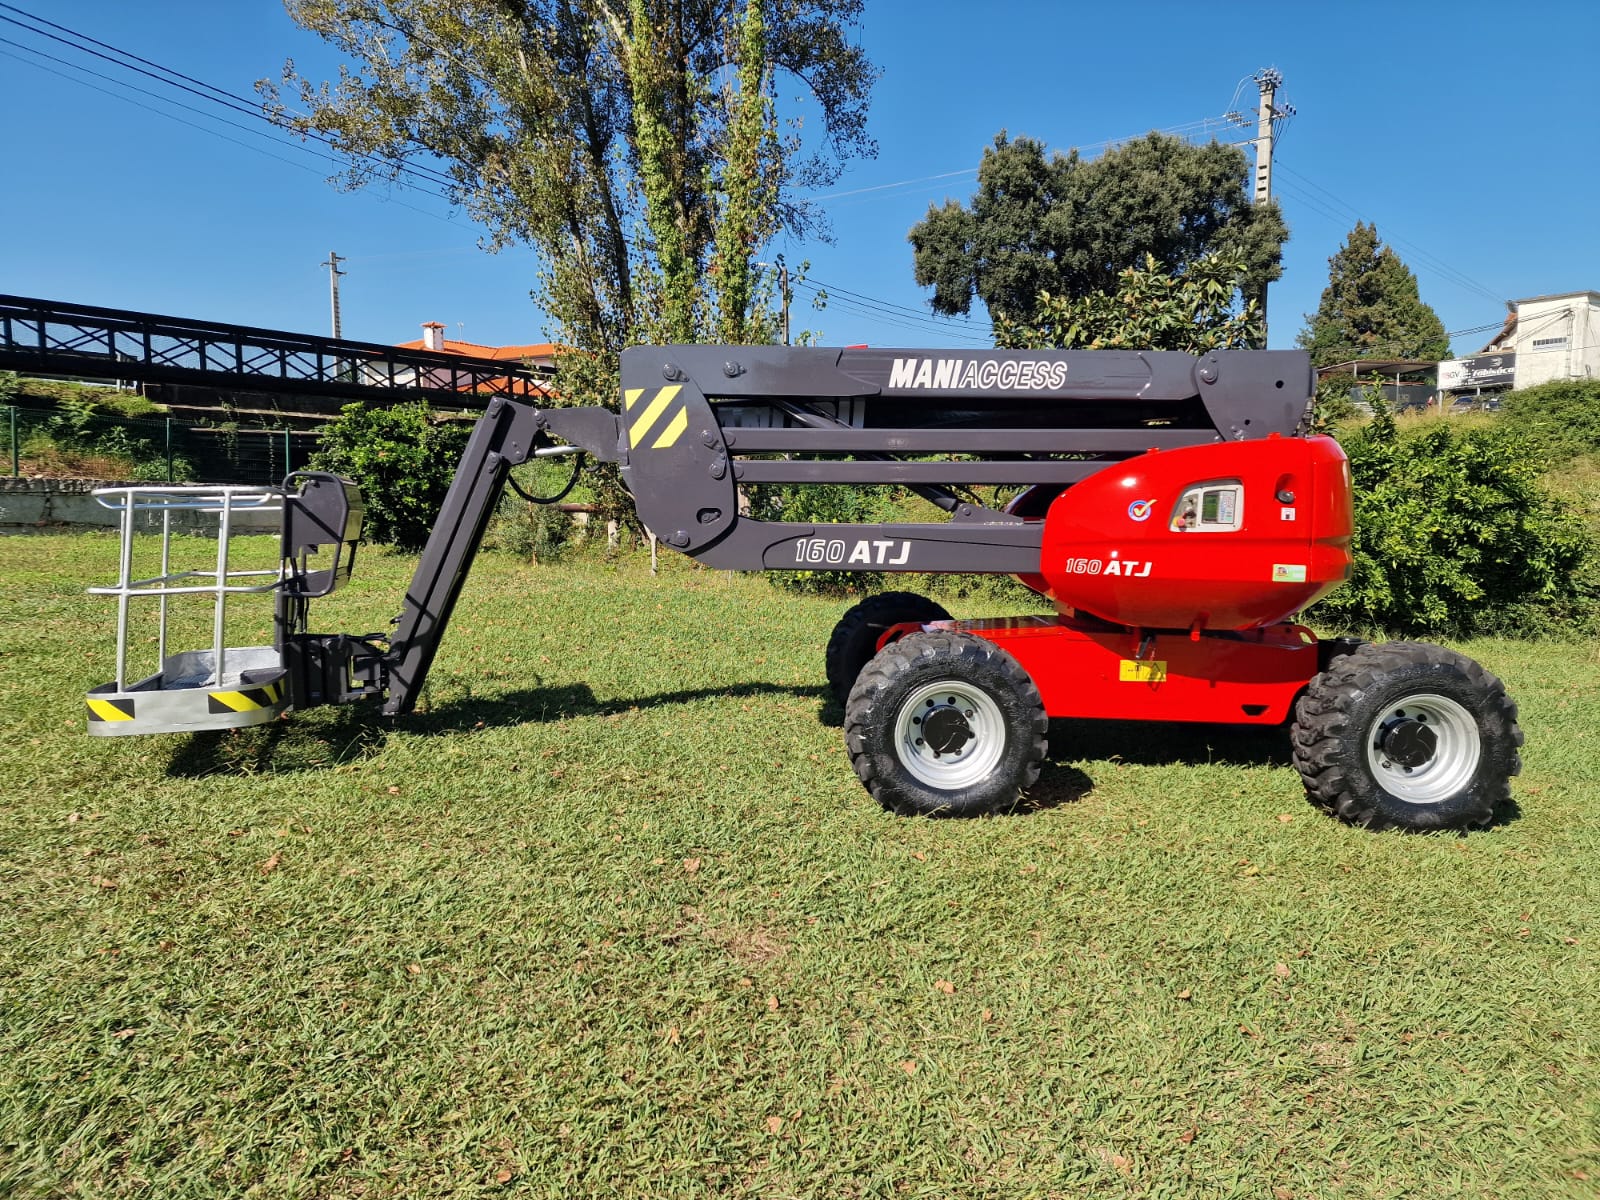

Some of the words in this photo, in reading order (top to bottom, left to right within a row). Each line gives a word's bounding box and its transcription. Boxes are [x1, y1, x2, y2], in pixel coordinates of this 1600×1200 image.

[888, 358, 1067, 390] MANIACCESS
[795, 538, 846, 563] 160
[848, 540, 911, 565] ATJ
[1065, 558, 1102, 575] 160
[1103, 560, 1152, 577] ATJ
